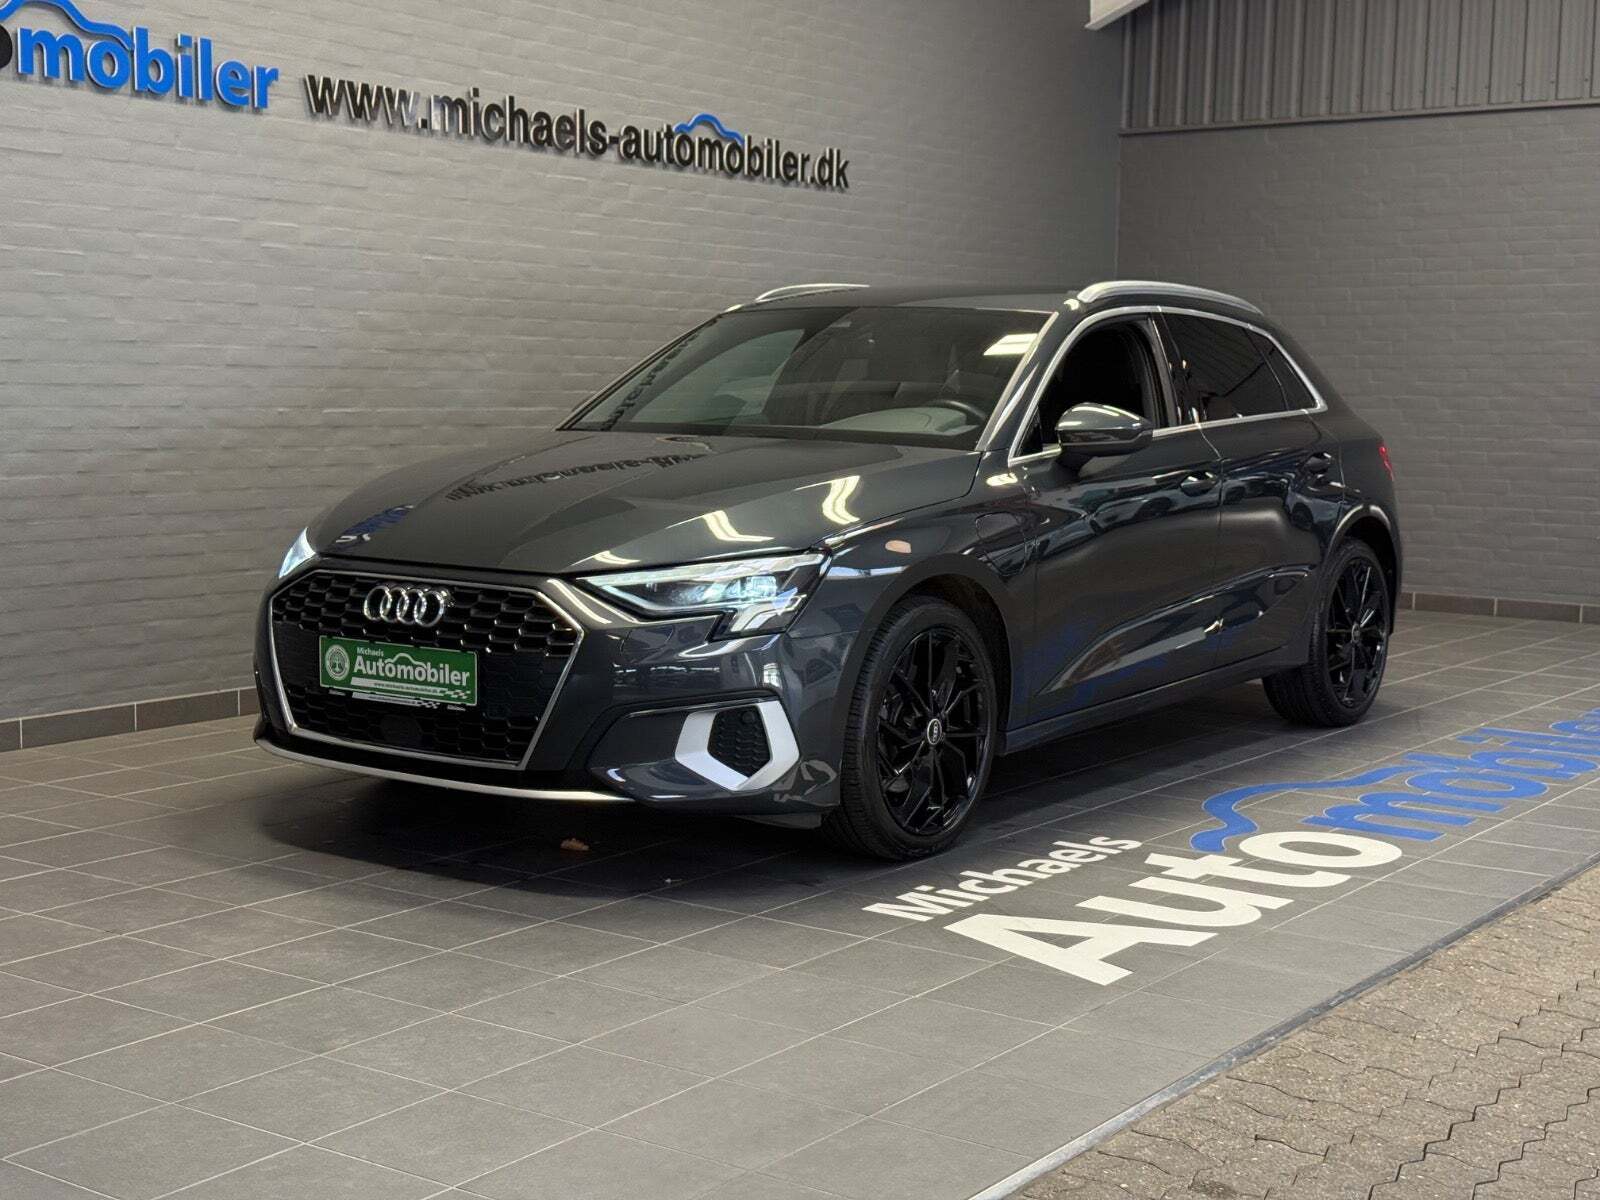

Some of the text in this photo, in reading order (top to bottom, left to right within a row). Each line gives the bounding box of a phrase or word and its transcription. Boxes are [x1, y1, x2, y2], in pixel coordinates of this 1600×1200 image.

[0, 25, 279, 109] mobiler
[305, 74, 849, 188] www.michaels-automobiler.dk
[353, 655, 470, 687] Automobiler
[861, 836, 1143, 922] Michaels
